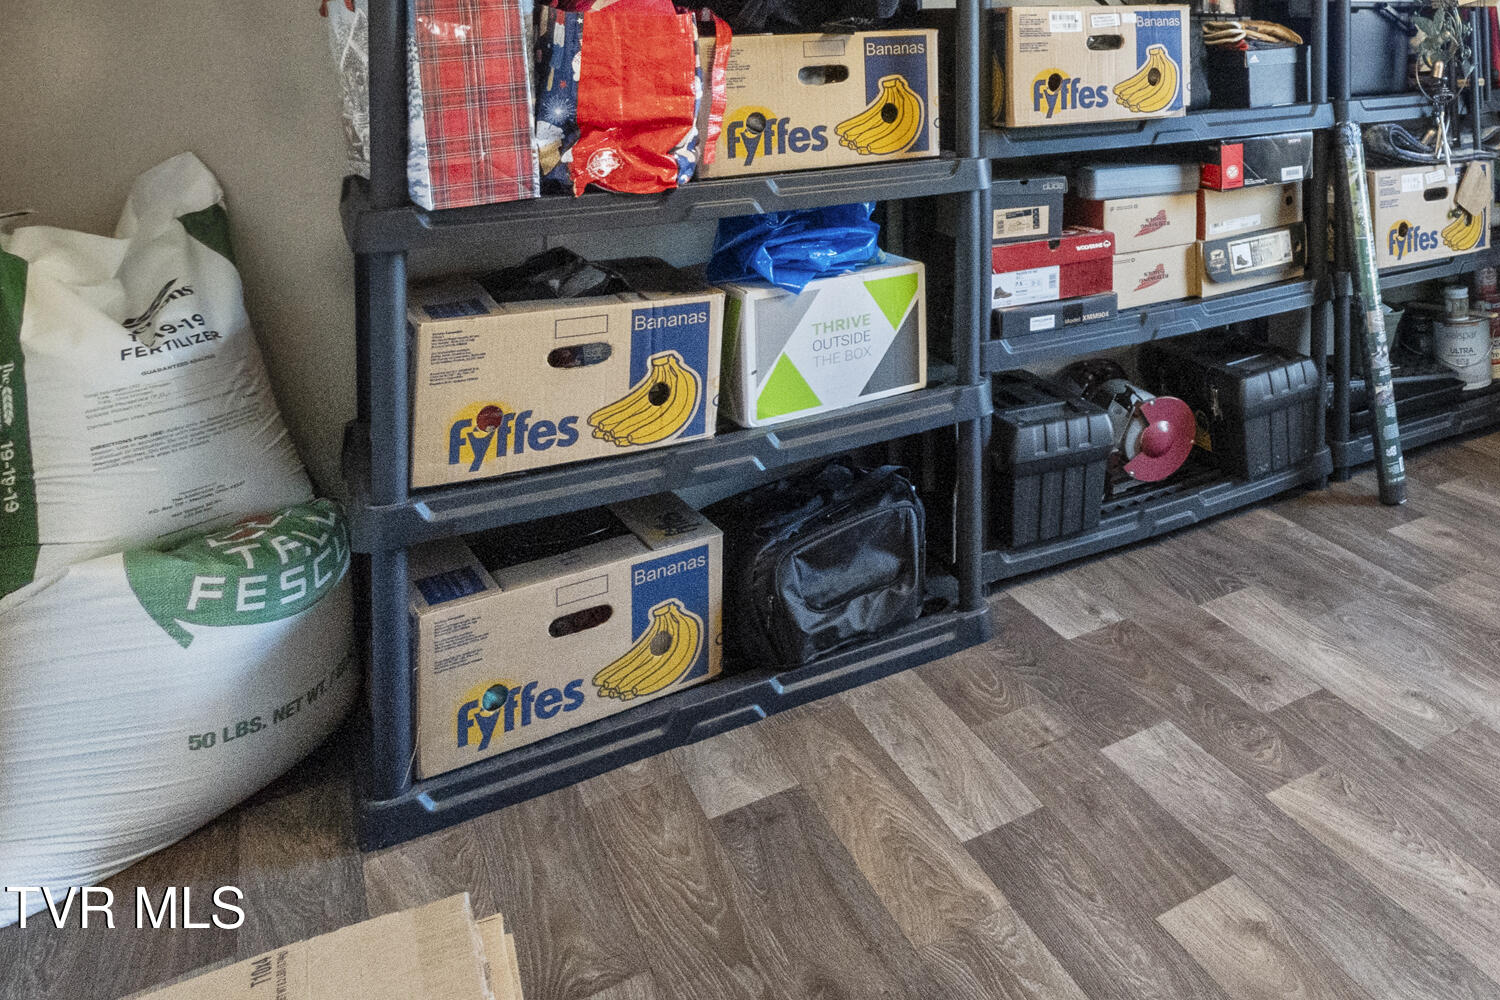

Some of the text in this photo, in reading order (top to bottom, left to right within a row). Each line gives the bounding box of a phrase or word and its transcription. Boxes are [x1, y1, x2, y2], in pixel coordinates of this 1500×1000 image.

[1137, 15, 1180, 27] Bananas
[866, 41, 925, 56] Bananas
[1034, 77, 1109, 119] fyffes
[727, 117, 828, 166] fyffes
[1389, 225, 1438, 260] fyffes
[635, 310, 708, 332] Bananas
[811, 313, 871, 336] THRIVE
[120, 330, 222, 361] FERTILIZER
[812, 329, 871, 352] OUTSIDE
[812, 345, 872, 368] THE BOX
[449, 410, 579, 472] fyffes
[634, 554, 706, 587] Bananas
[188, 731, 216, 751] 50
[222, 716, 267, 744] LBS.
[272, 696, 304, 725] NET
[457, 679, 585, 751] fyffes
